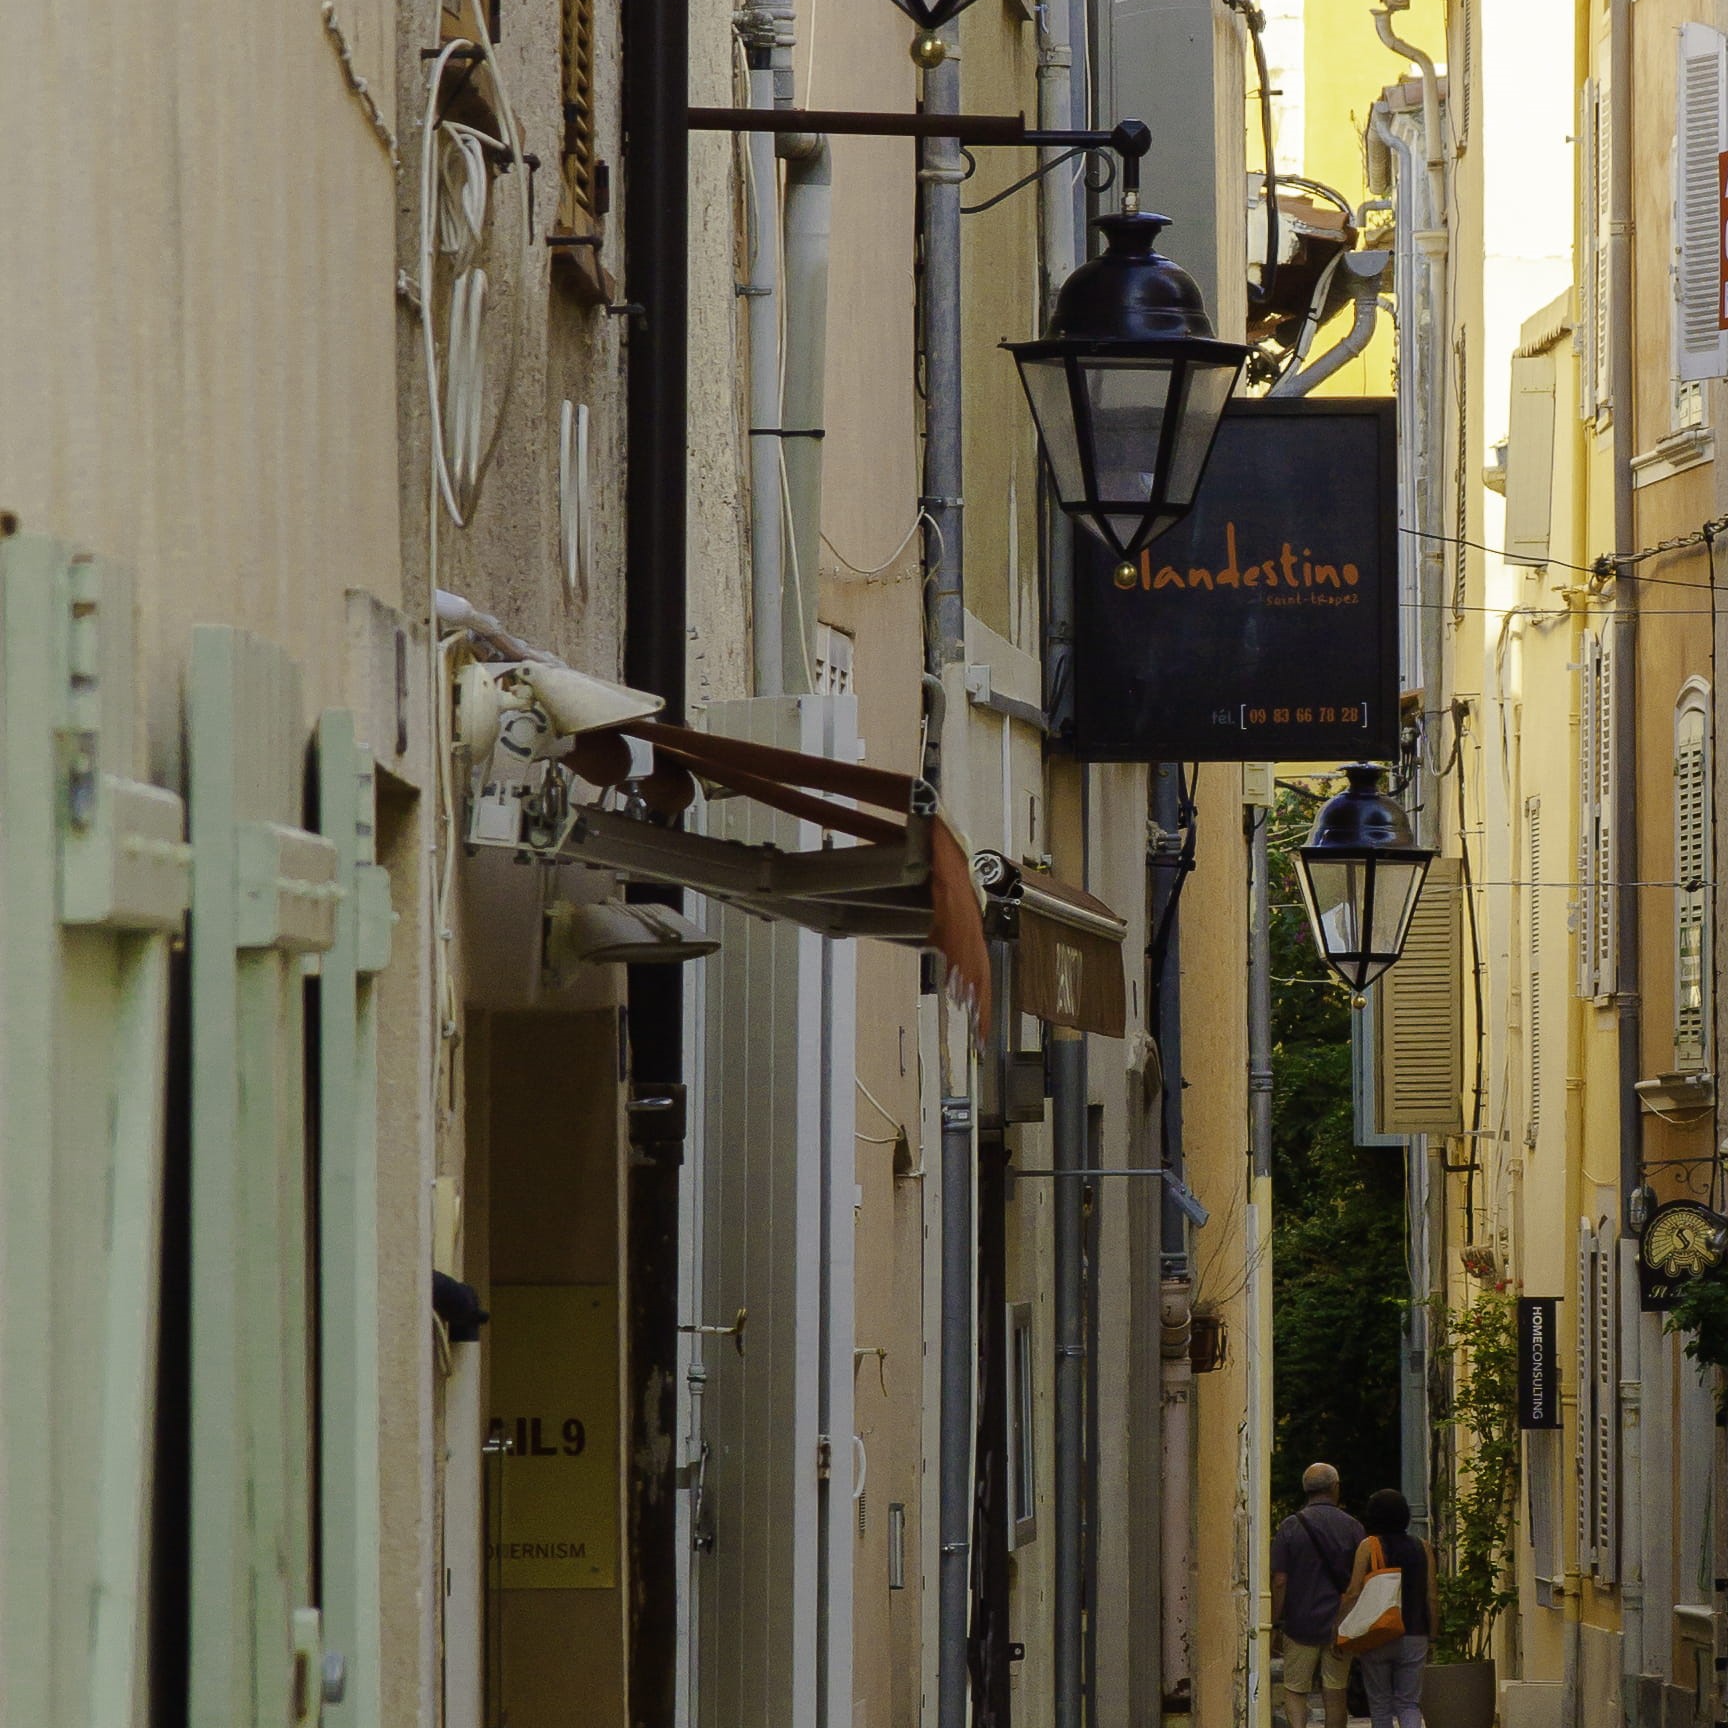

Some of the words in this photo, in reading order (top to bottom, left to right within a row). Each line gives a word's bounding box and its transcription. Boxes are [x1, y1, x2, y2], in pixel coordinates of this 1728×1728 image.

[1296, 707, 1313, 723] 66
[1532, 1306, 1543, 1420] HOMECONSULTING
[562, 1417, 586, 1457] 9
